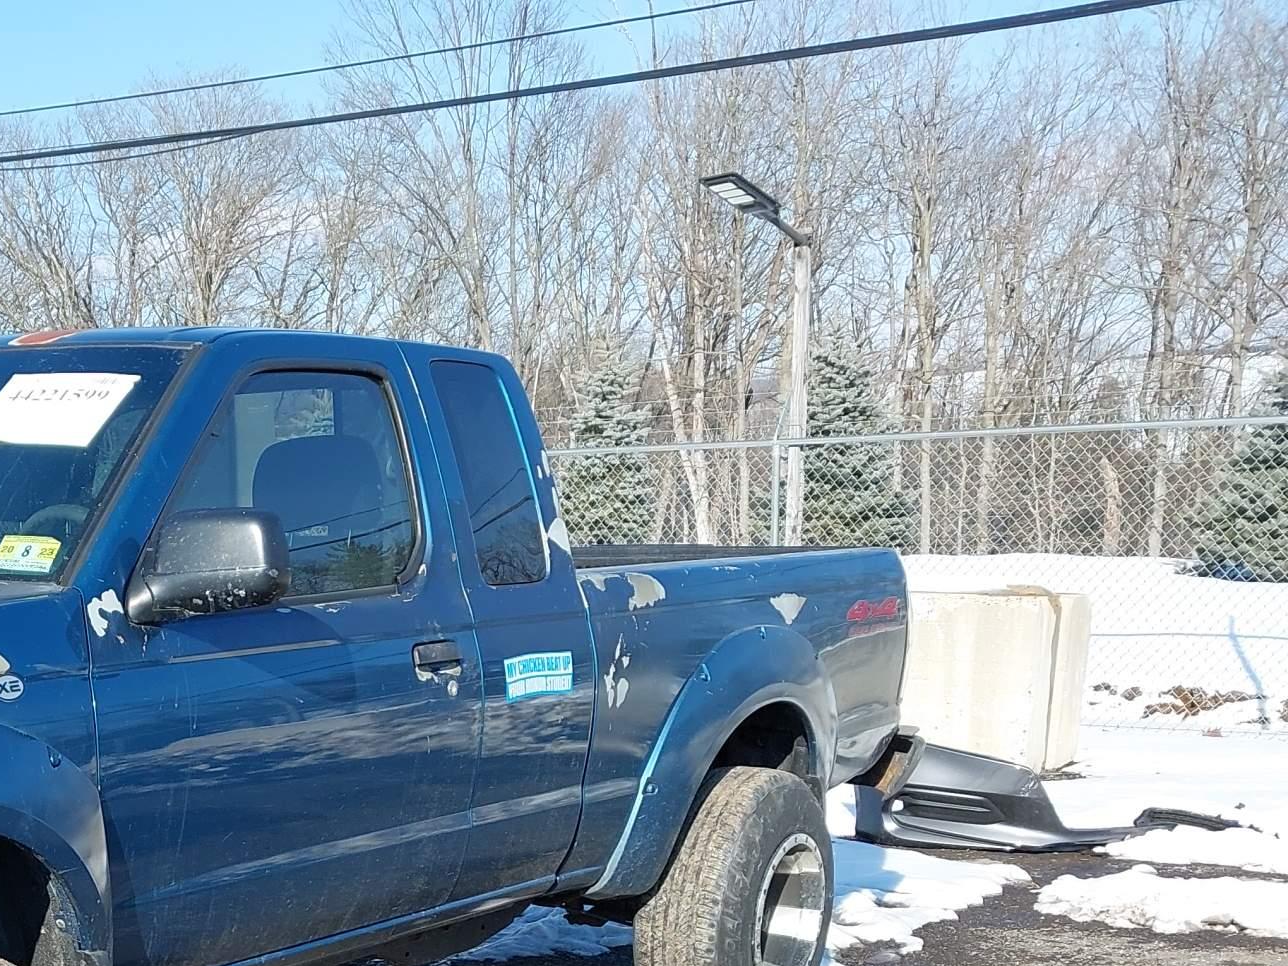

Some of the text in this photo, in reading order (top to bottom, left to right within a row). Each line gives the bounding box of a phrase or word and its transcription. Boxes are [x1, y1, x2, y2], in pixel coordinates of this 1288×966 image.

[9, 388, 111, 402] 44221599
[0, 545, 15, 554] 20
[21, 544, 33, 558] 8
[506, 655, 571, 679] MY CHICKEN BEAT UP
